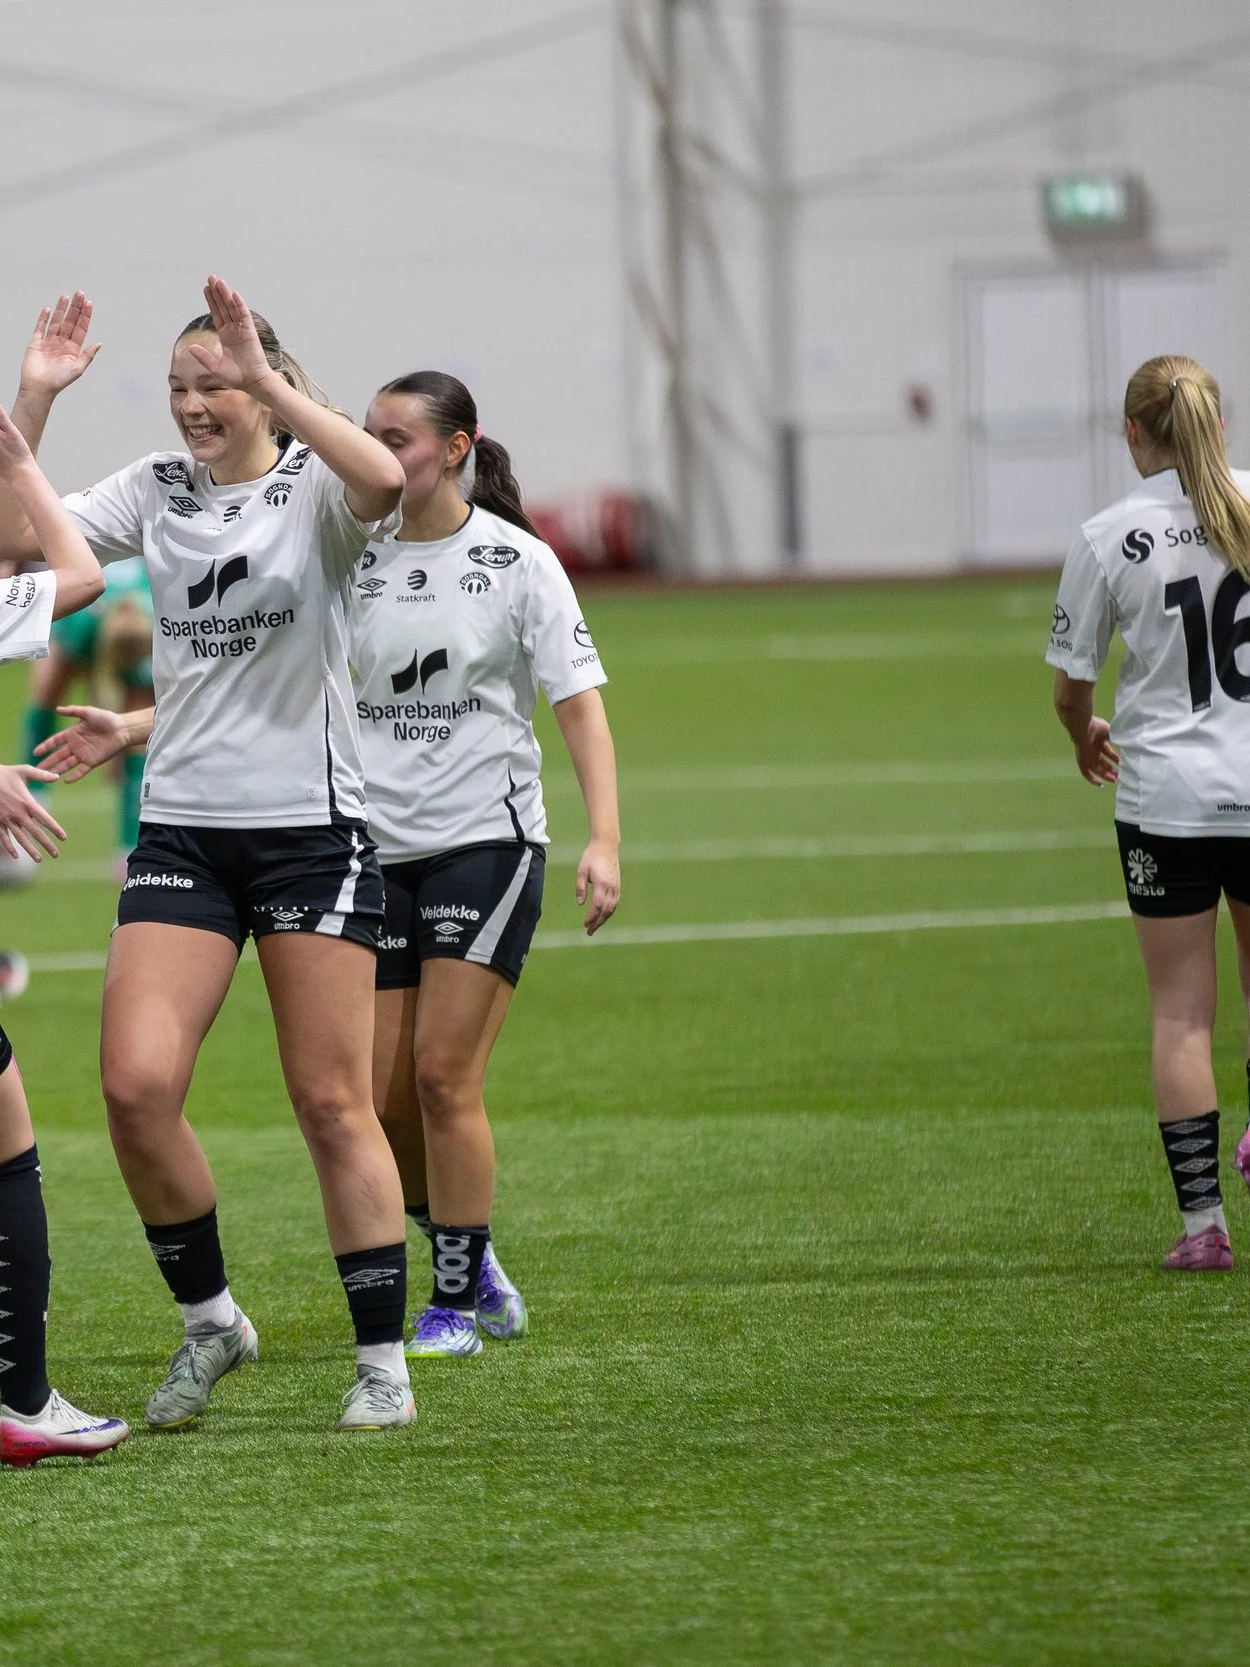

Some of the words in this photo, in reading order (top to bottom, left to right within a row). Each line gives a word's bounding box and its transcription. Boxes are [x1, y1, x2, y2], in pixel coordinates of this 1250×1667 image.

[167, 506, 193, 519] umbro
[470, 546, 515, 567] Lerum
[360, 591, 383, 601] umbro
[396, 593, 436, 603] Statkraft
[160, 608, 295, 641] Sparebanken
[191, 635, 257, 659] Norge
[1165, 568, 1250, 714] 16
[357, 697, 482, 723] Sparebanken
[394, 722, 451, 743] Norge
[1128, 882, 1165, 896] mesta
[420, 905, 480, 921] Veidekke
[274, 922, 300, 930] umbro
[435, 936, 460, 944] umbro
